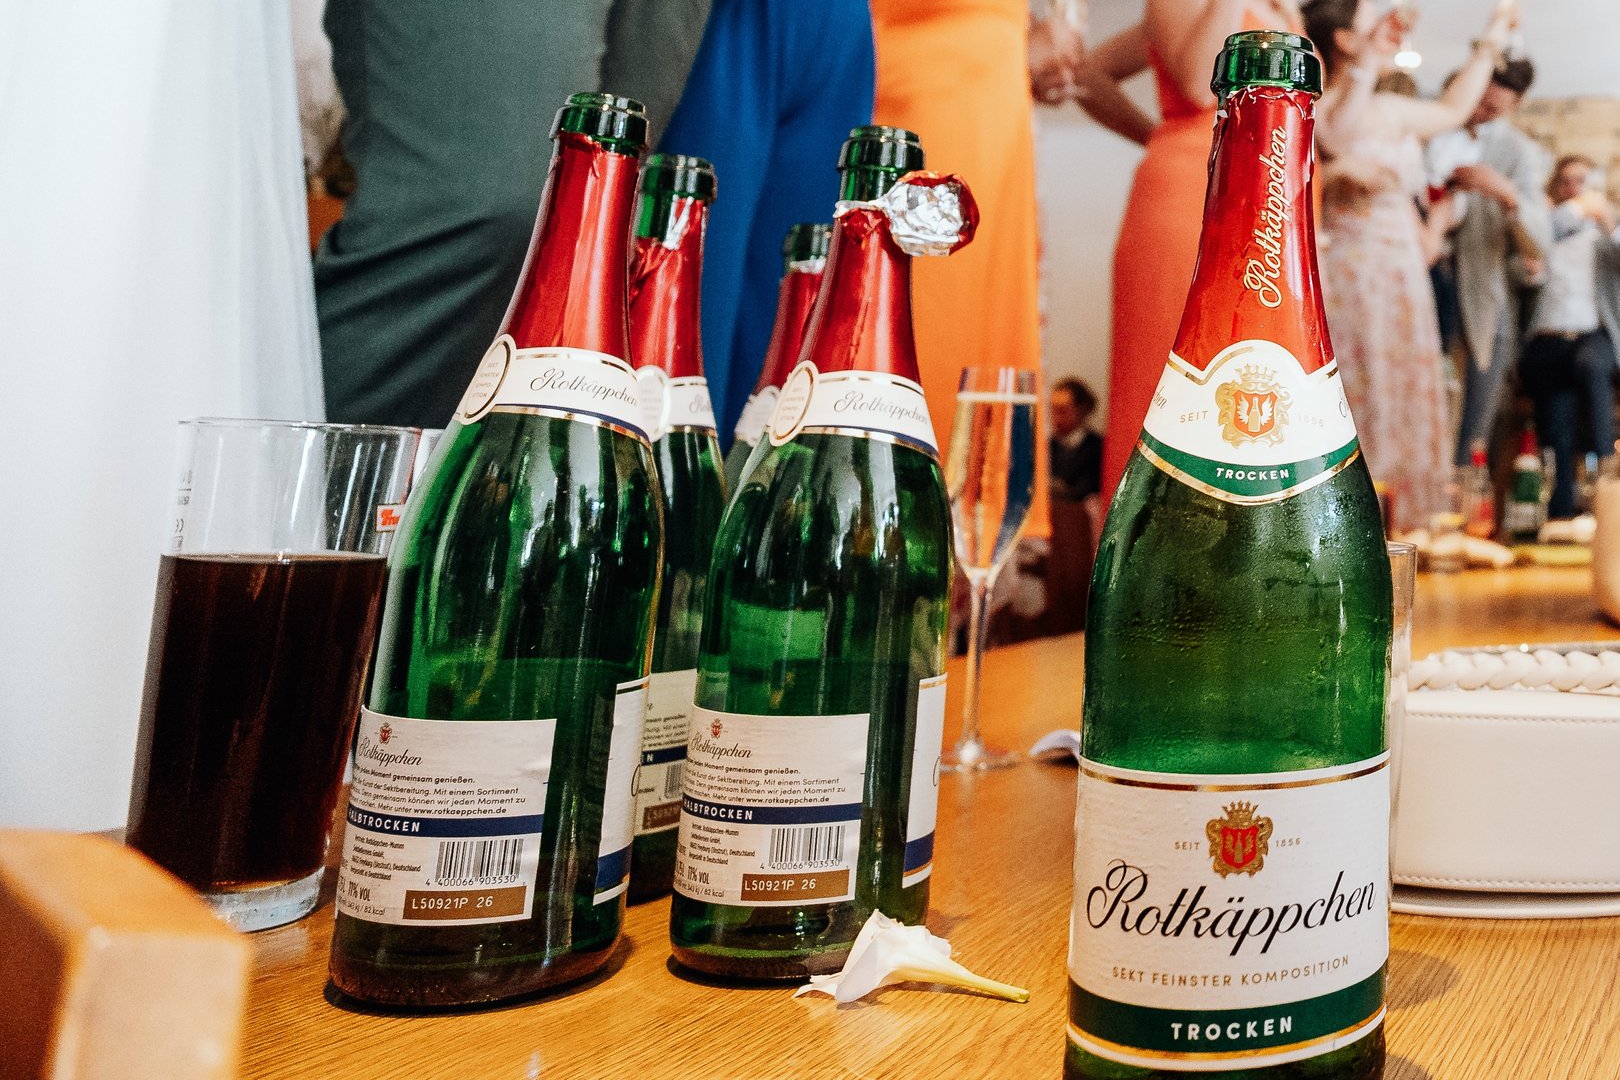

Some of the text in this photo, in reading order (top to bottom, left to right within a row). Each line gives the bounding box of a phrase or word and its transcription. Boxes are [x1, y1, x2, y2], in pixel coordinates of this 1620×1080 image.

[1243, 126, 1289, 308] Rotkäppchen
[530, 367, 638, 407] Rotkäppchen
[834, 391, 929, 425] Rotkäppchen
[1180, 410, 1209, 424] SEIT
[1216, 467, 1290, 482] TROCKEN
[359, 738, 423, 767] Rotkäppchen
[691, 732, 752, 759] Rotkäppchen
[725, 766, 762, 775] gemeinsam
[764, 767, 800, 776] genießen.
[392, 773, 433, 783] gemeinsam
[434, 776, 475, 785] genießen.
[717, 775, 761, 787] Sektbereitung.
[802, 778, 839, 786] Sortiment
[383, 783, 431, 797] Sektbereitung.
[433, 788, 447, 796] Mit
[449, 788, 474, 796] einem
[477, 787, 519, 796] Sortiment
[707, 784, 739, 793] gemeinsam
[740, 787, 765, 795] können
[779, 788, 801, 796] jeden
[372, 793, 406, 803] gemeinsam
[408, 796, 435, 805] können
[450, 798, 475, 807] jeden
[477, 797, 513, 805] Moment
[712, 792, 727, 800] Mehr
[746, 796, 830, 806] www.rotkaeppchen.de
[377, 802, 393, 811] Mehr
[394, 805, 412, 813] unter
[413, 806, 507, 817] www.rotkaeppchen.de
[1174, 837, 1301, 851] SEIT 1856
[771, 862, 803, 870] 400066
[808, 858, 840, 868] 903530
[437, 878, 474, 886] 400066
[479, 875, 516, 885] 903530
[699, 871, 709, 885] VOL
[744, 879, 816, 891] L50921P 26
[359, 885, 371, 901] VOL
[712, 889, 725, 898] kcal
[412, 895, 494, 910] L50921P 26
[1086, 858, 1376, 956] Rotkäppchen
[372, 907, 386, 916] kcal
[1112, 956, 1350, 987] SEKT FEINSTER KOMPOSITION
[1171, 1016, 1293, 1041] TROCKEN
